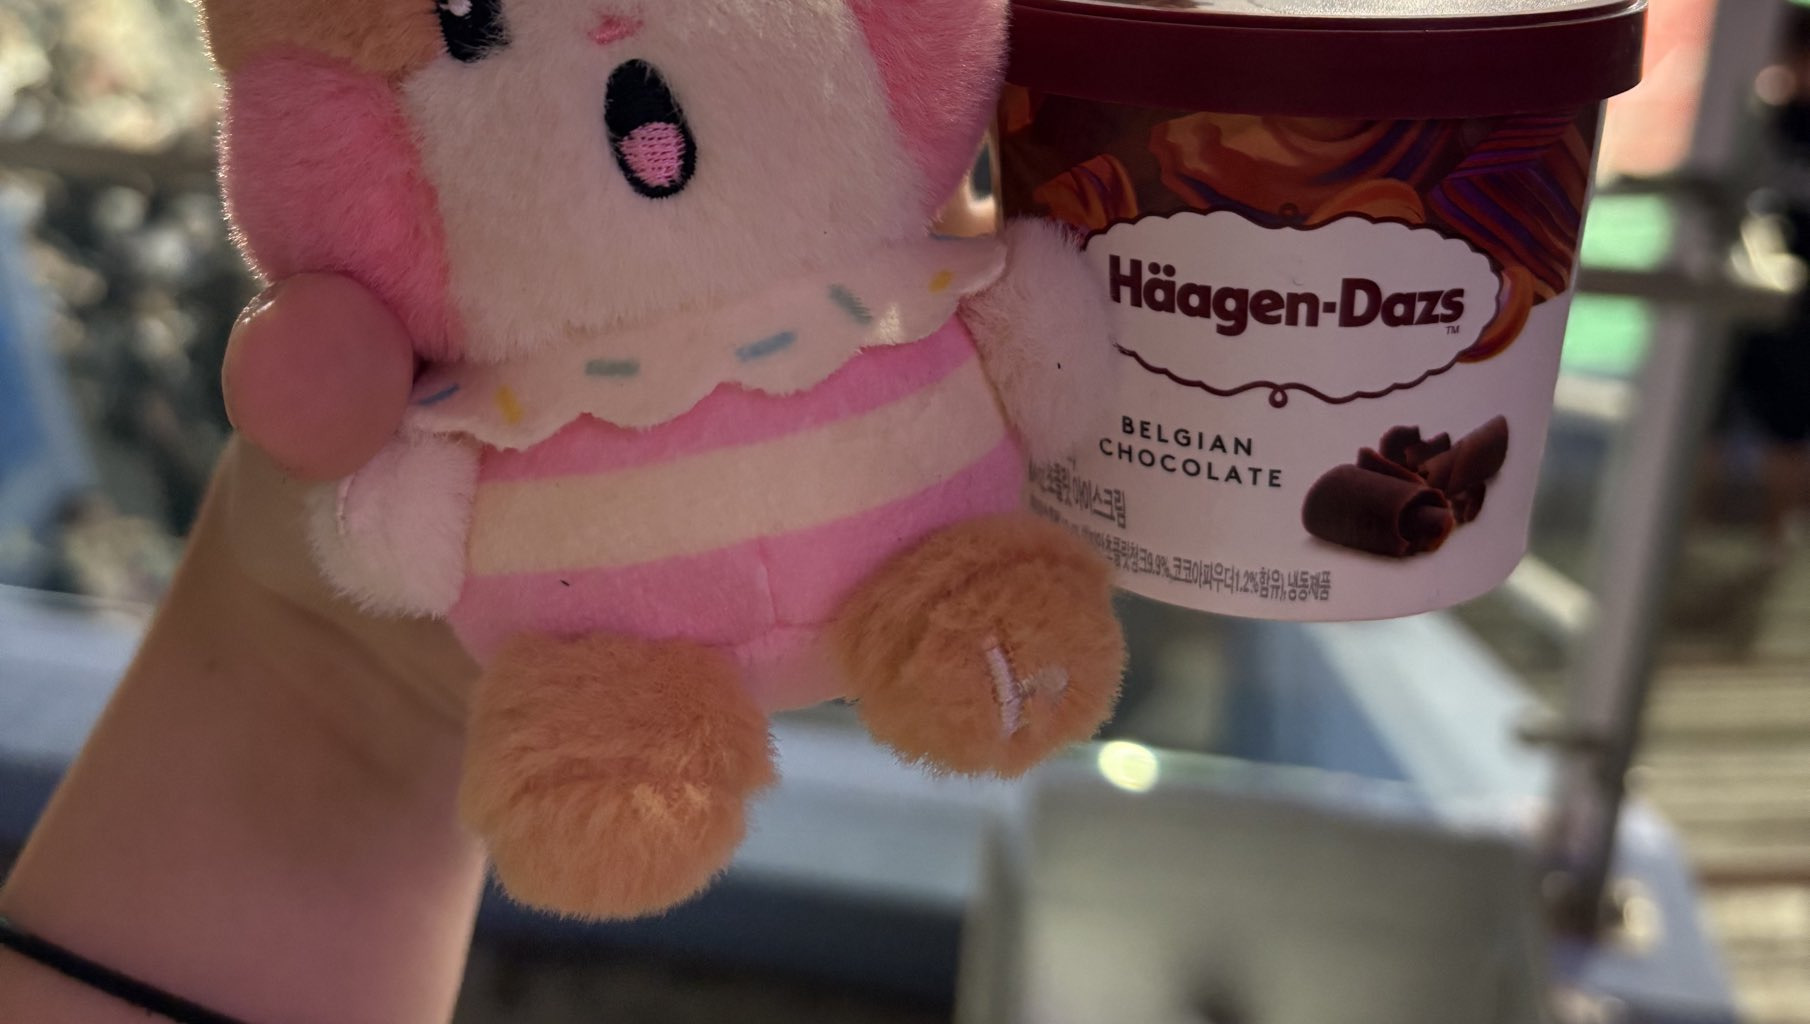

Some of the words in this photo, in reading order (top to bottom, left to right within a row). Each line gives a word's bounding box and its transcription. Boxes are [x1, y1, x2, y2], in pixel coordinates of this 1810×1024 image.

[1109, 254, 1465, 336] Häagen-Dazs
[1121, 415, 1253, 456] BELGIAN
[1099, 438, 1283, 488] CHOCOLATE
[1072, 476, 1126, 528] 아이스크림
